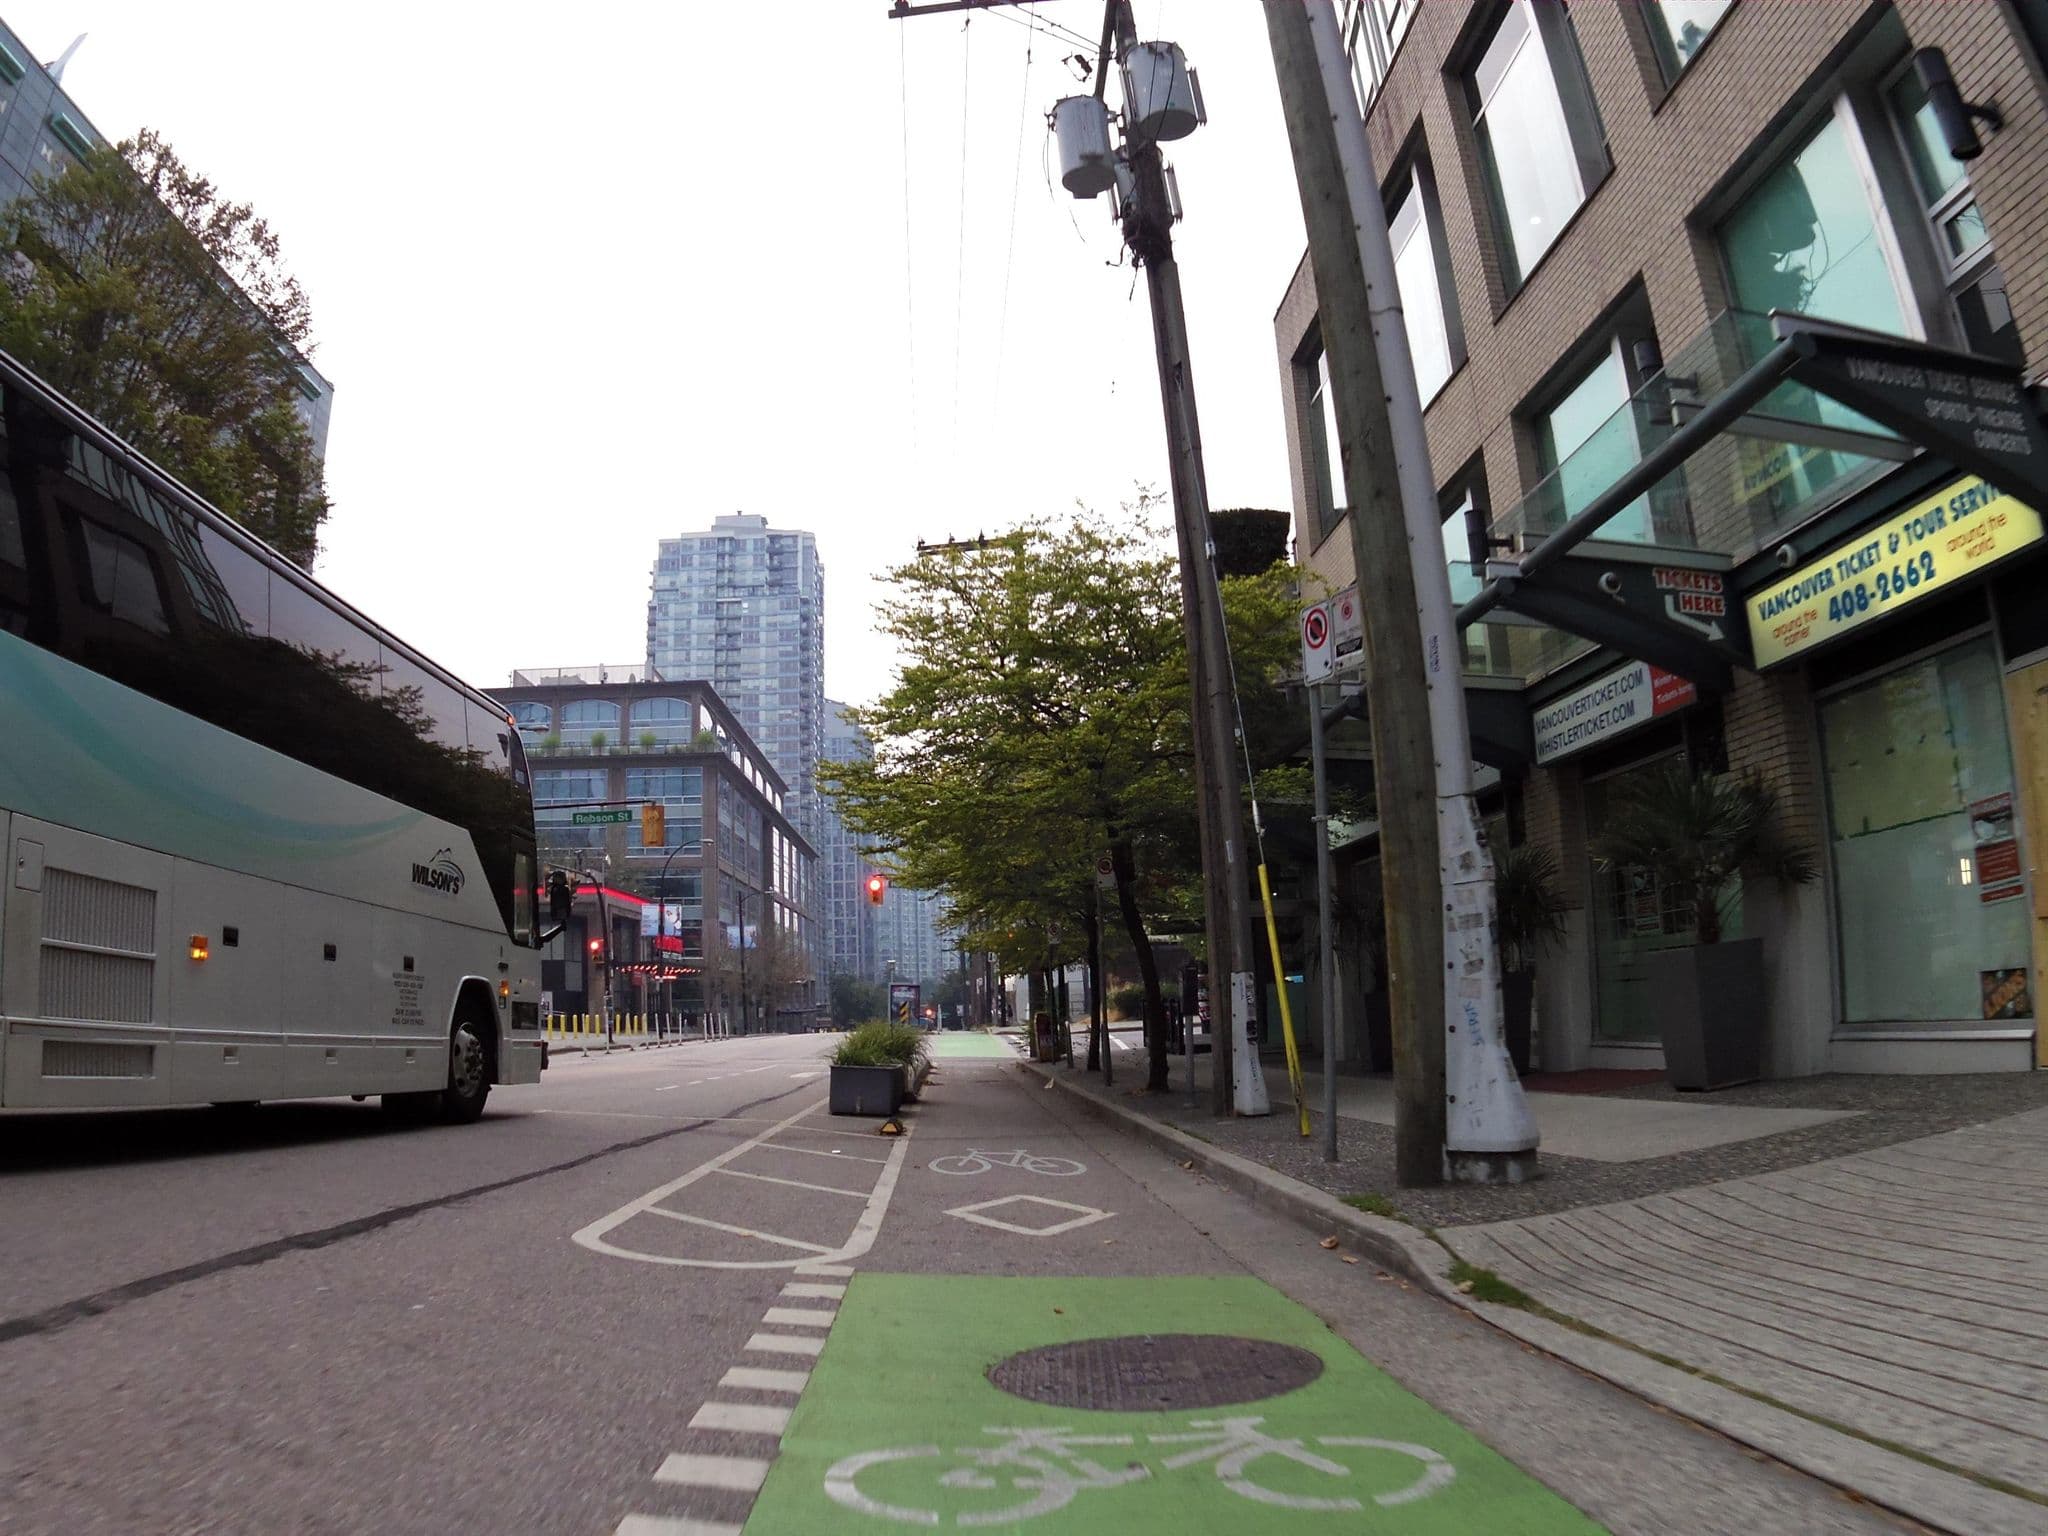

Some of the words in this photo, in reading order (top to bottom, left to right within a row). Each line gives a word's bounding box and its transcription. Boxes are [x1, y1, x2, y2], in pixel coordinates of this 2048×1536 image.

[1653, 567, 1723, 593] TICKETS
[1758, 567, 1835, 621] VANCOUVER
[1836, 540, 1883, 583] TICKET
[1887, 531, 1900, 554] &
[1903, 506, 1948, 546] TOUR
[1828, 550, 1937, 622] 408-2662
[1680, 591, 1726, 616] HERE
[1535, 668, 1645, 736] VANCOUVERTICKET.COM
[1537, 699, 1636, 757] WHISTLERTICKET.COM
[575, 813, 615, 824] Robson
[617, 812, 629, 822] St
[412, 862, 460, 895] WILSON'S
